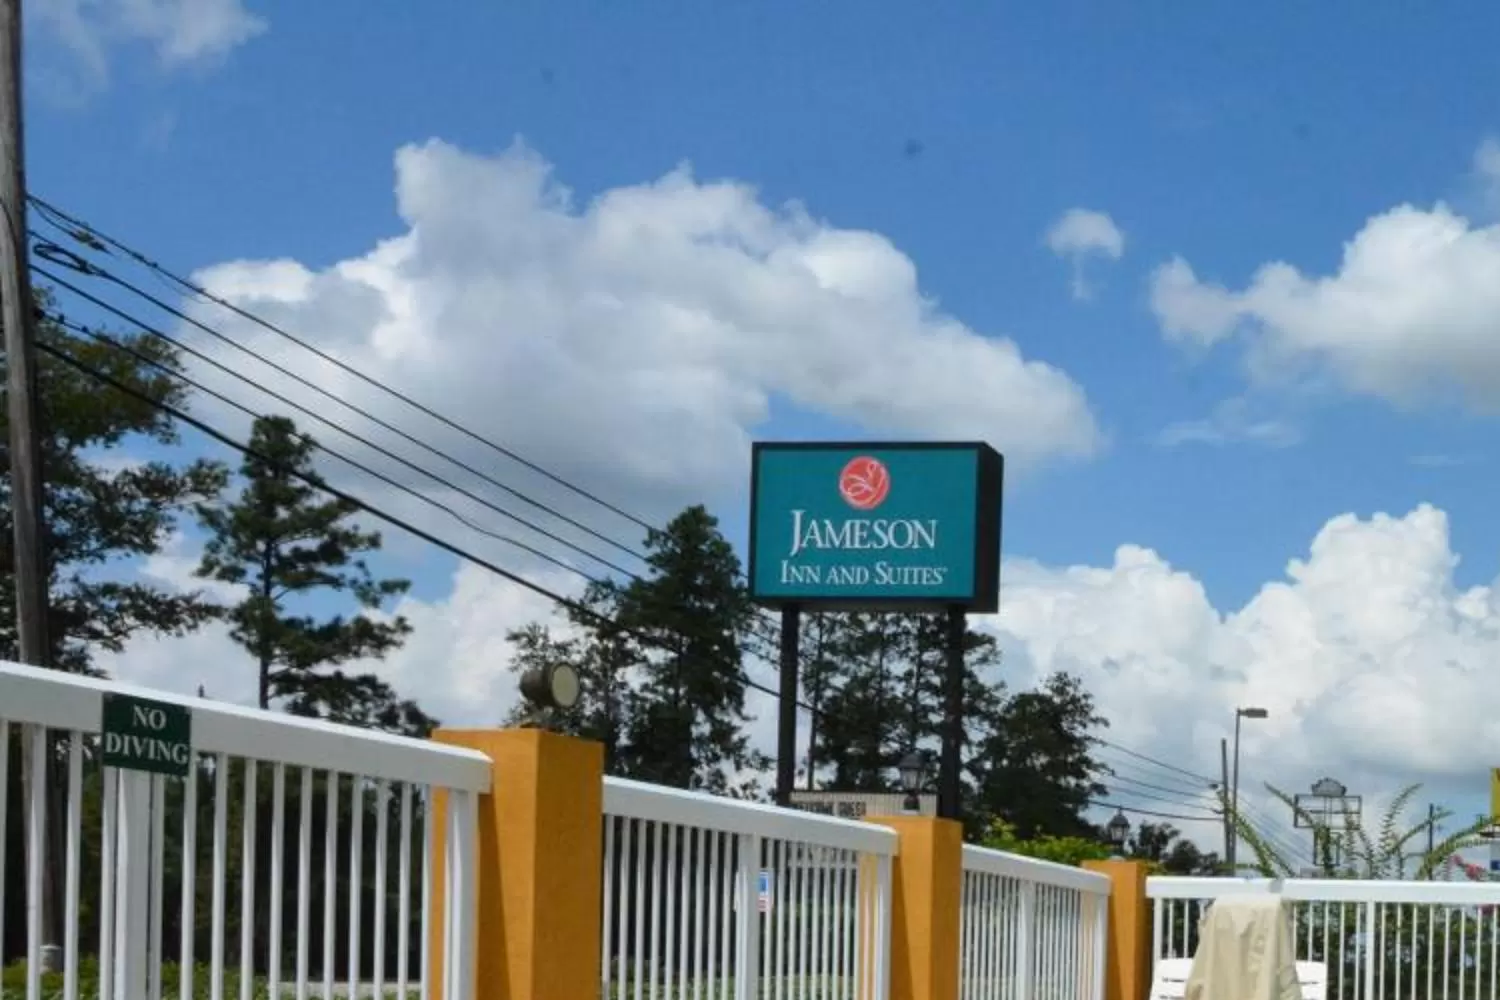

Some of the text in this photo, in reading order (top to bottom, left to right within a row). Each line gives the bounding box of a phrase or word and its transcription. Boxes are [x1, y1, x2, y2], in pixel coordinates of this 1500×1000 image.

[789, 509, 938, 557] JAMESON
[781, 560, 944, 585] INN AND SUITES
[132, 703, 167, 731] NO
[105, 731, 189, 765] DIVING
